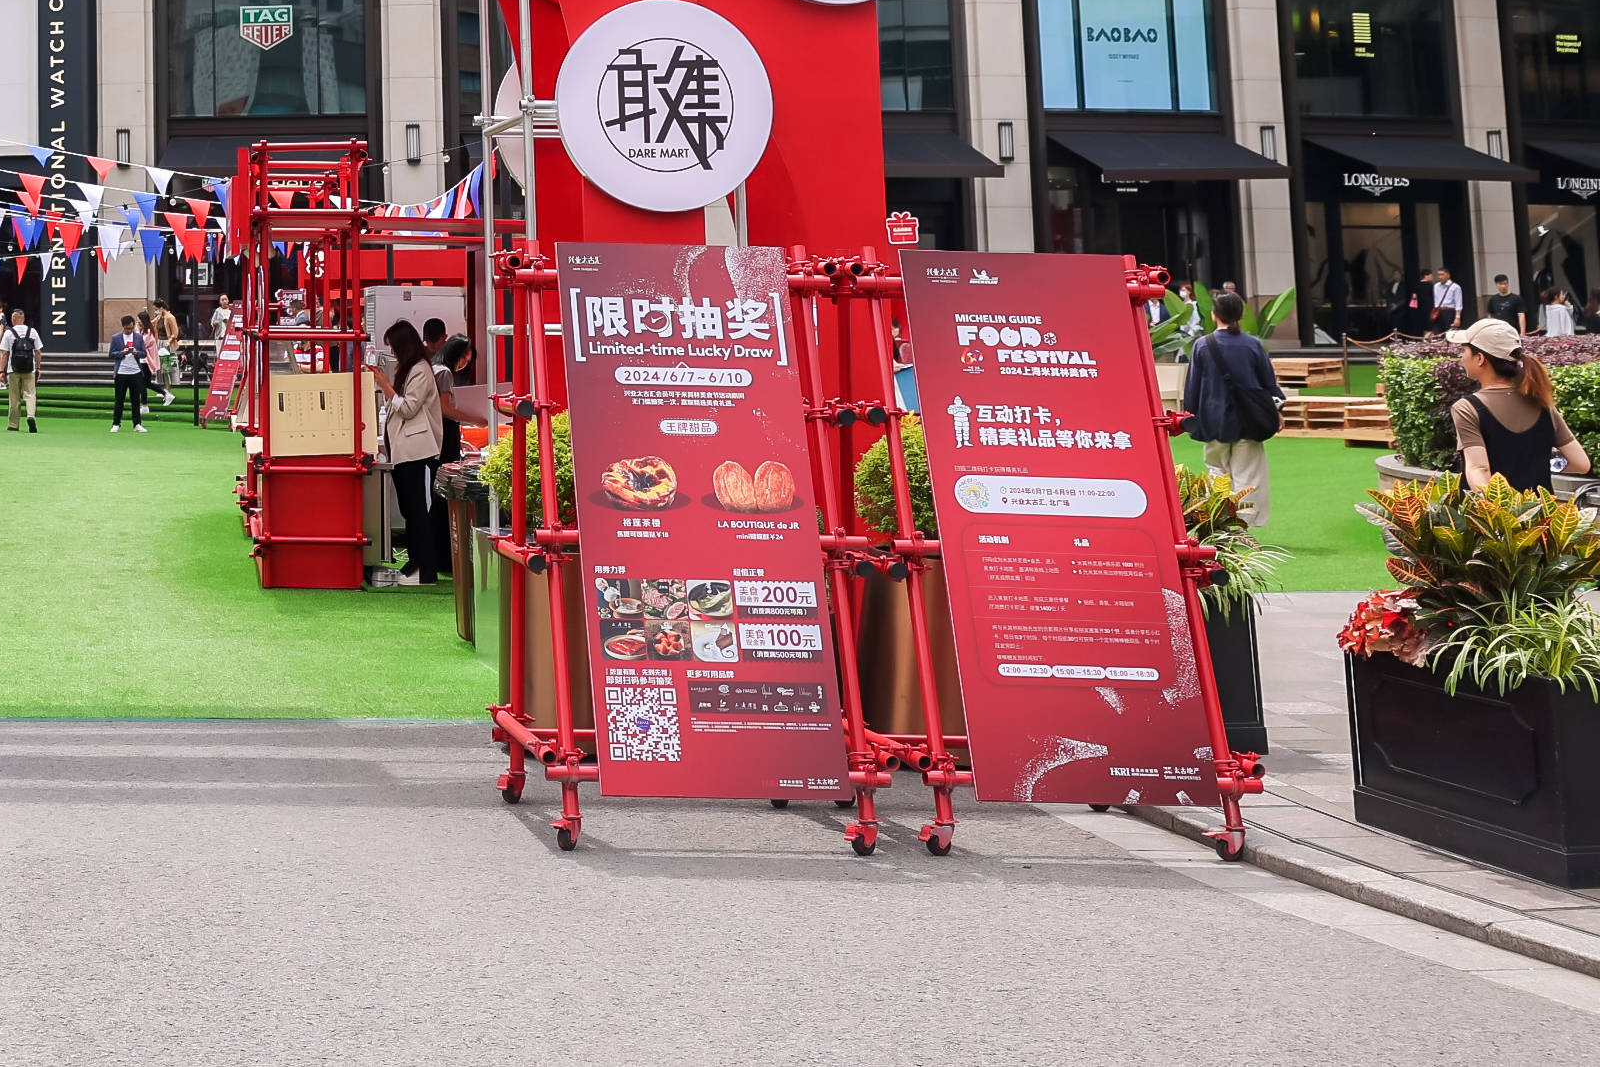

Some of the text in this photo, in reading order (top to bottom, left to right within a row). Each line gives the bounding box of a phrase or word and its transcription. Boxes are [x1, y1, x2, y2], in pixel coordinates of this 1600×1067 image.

[244, 9, 289, 22] TAG
[244, 25, 290, 46] HEUER
[50, 20, 66, 109] WATCH
[628, 148, 690, 159] DARE MART
[1343, 173, 1410, 188] LONGINES
[585, 295, 772, 341] 限时抽奖
[955, 314, 1042, 324] MICHELIN GUIDE
[956, 325, 1041, 347] FOOD
[589, 342, 773, 361] Limited-time Lucky Draw
[1000, 366, 1098, 378] 2024上海米其林美食节
[666, 422, 712, 433] 王牌甜品
[978, 427, 1132, 450] 精美礼品等你来拿
[718, 520, 729, 528] LA
[731, 521, 775, 530] BOUTIQUE
[1073, 538, 1090, 547] 礼品
[1002, 666, 1021, 674] 12:00
